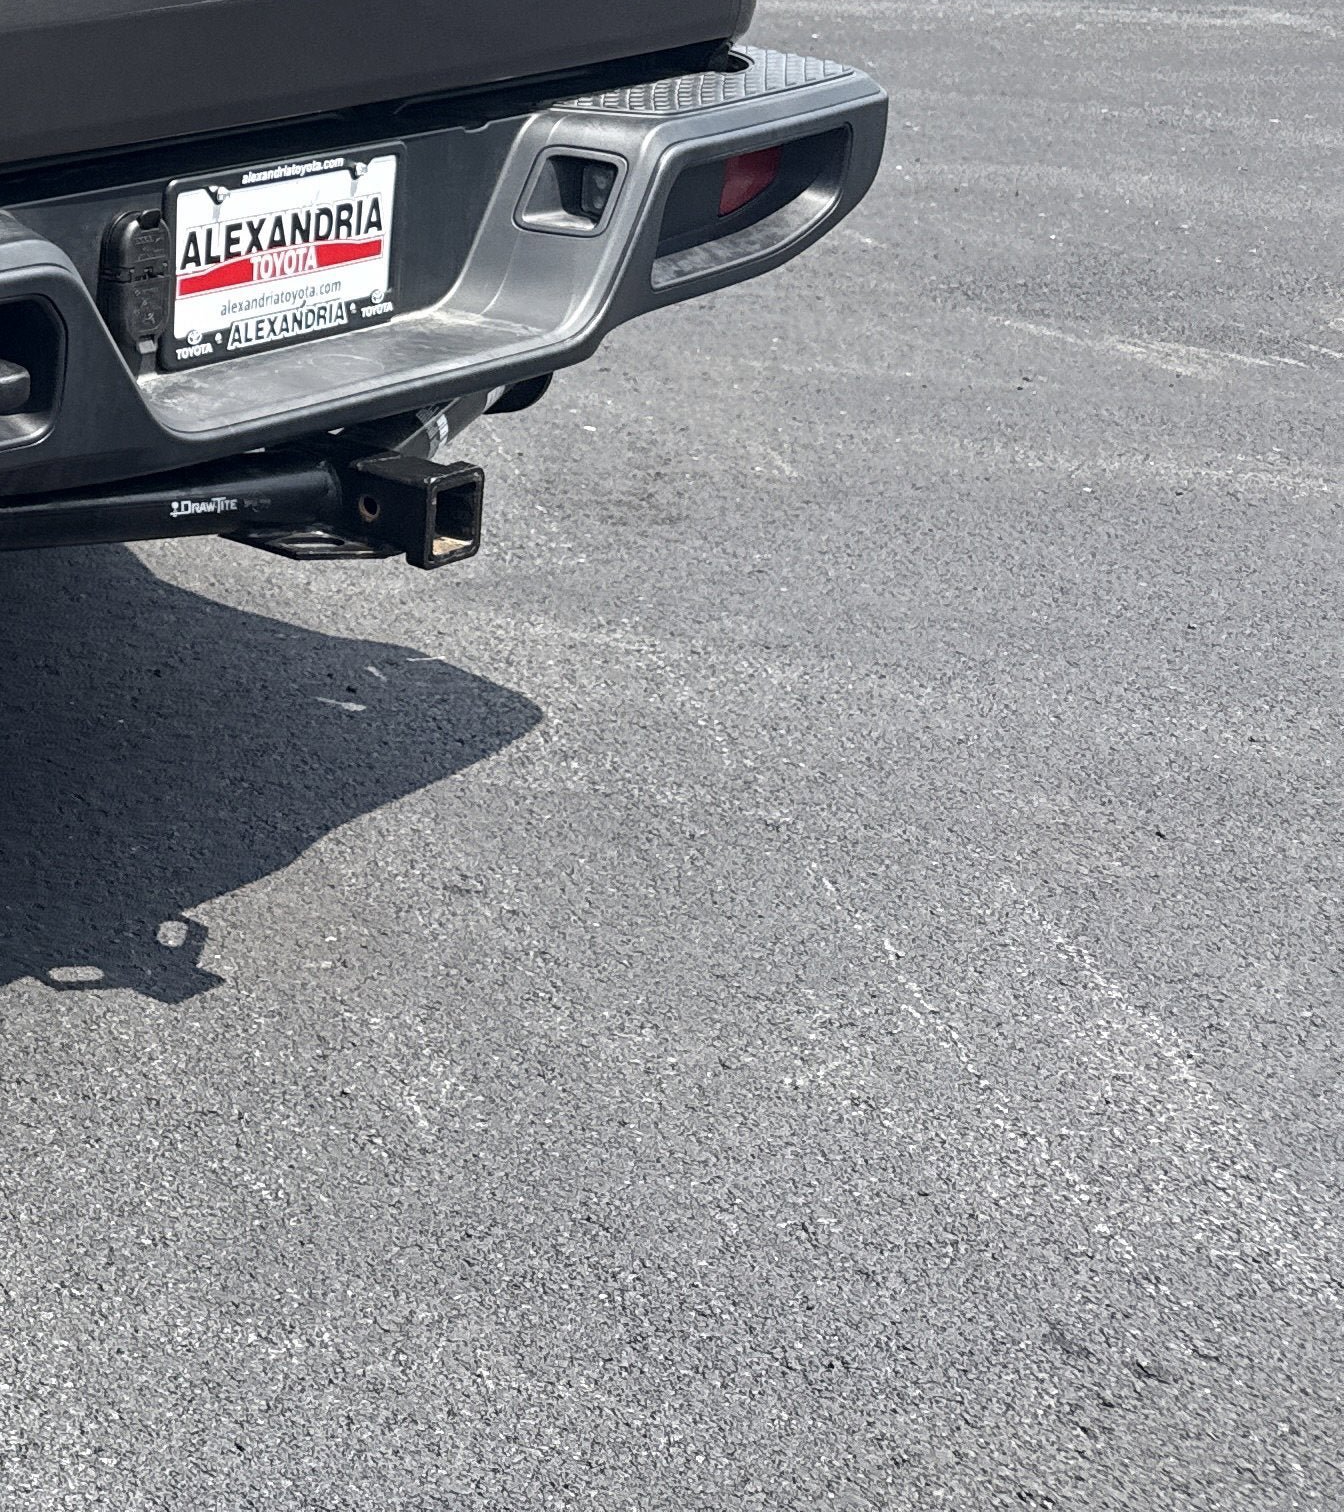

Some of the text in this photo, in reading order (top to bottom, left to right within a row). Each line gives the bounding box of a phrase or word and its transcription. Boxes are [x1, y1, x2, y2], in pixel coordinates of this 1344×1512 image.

[242, 157, 344, 184] alexandriatoyota.com
[179, 197, 383, 271] ALEXANDRIA
[250, 245, 318, 281] TOYOTA
[220, 279, 342, 316] alexandriatoyota.com
[360, 302, 393, 317] TOYOTA
[229, 303, 345, 348] ALEXANDRIA
[176, 343, 213, 360] TOYOTA
